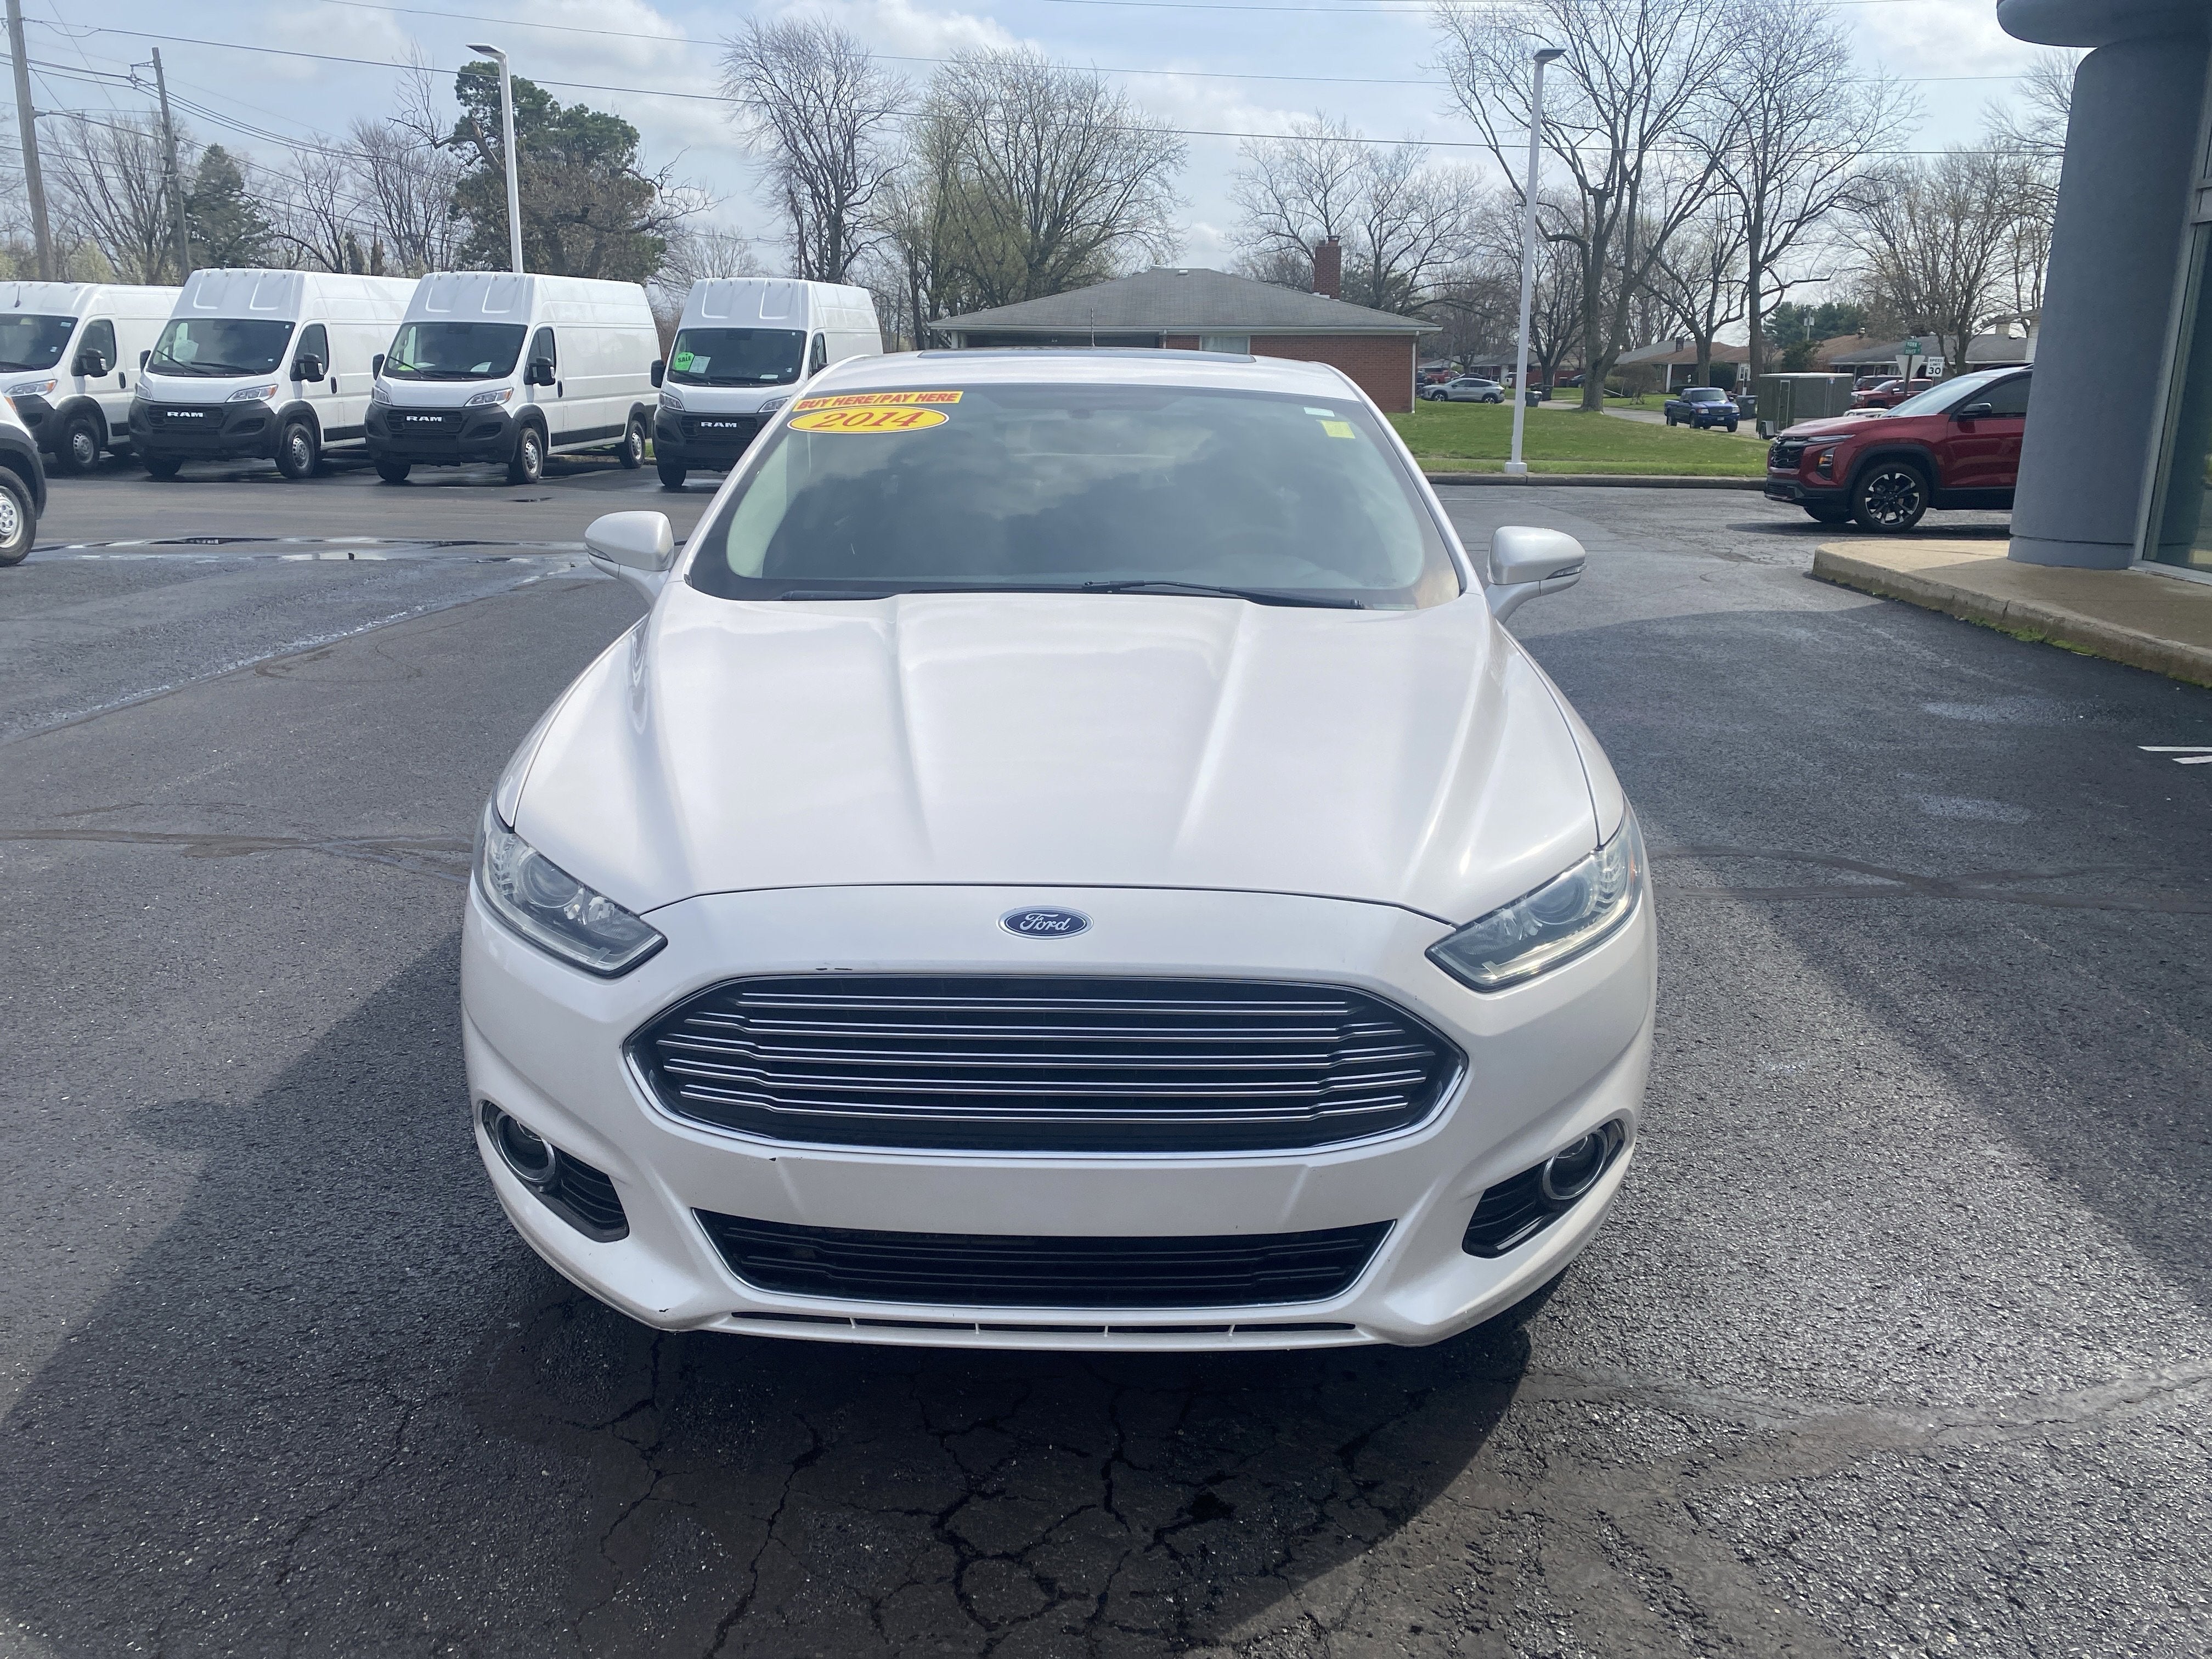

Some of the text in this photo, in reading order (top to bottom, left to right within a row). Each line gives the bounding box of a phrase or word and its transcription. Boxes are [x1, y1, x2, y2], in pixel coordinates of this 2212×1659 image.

[797, 393, 960, 410] BUY HERE/PAY HERE
[810, 411, 925, 428] 2014
[1019, 912, 1071, 931] Ford
